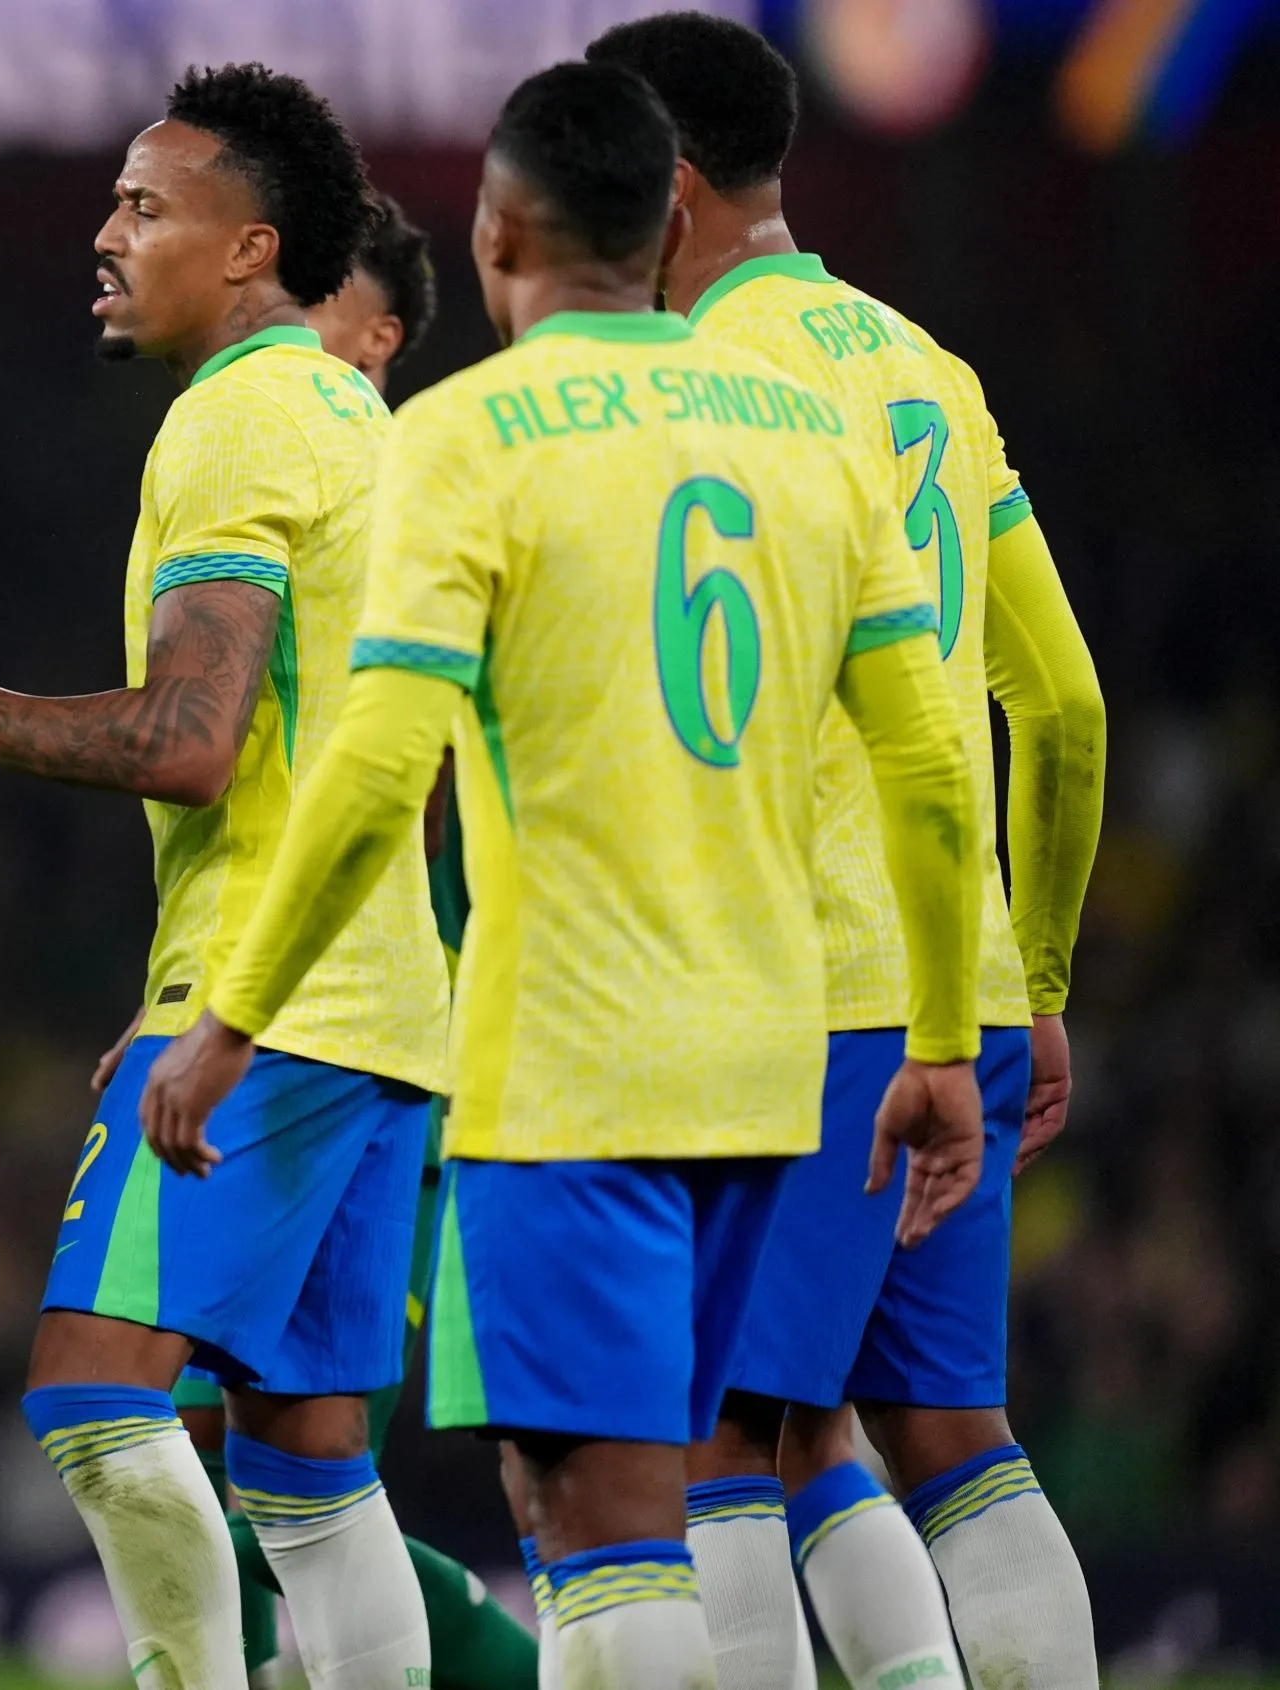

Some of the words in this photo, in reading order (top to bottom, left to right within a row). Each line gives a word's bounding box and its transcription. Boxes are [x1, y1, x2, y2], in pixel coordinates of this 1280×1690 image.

[483, 372, 641, 447] ALEX
[886, 398, 964, 662] 3
[653, 475, 762, 769] 6
[63, 1122, 108, 1222] 2
